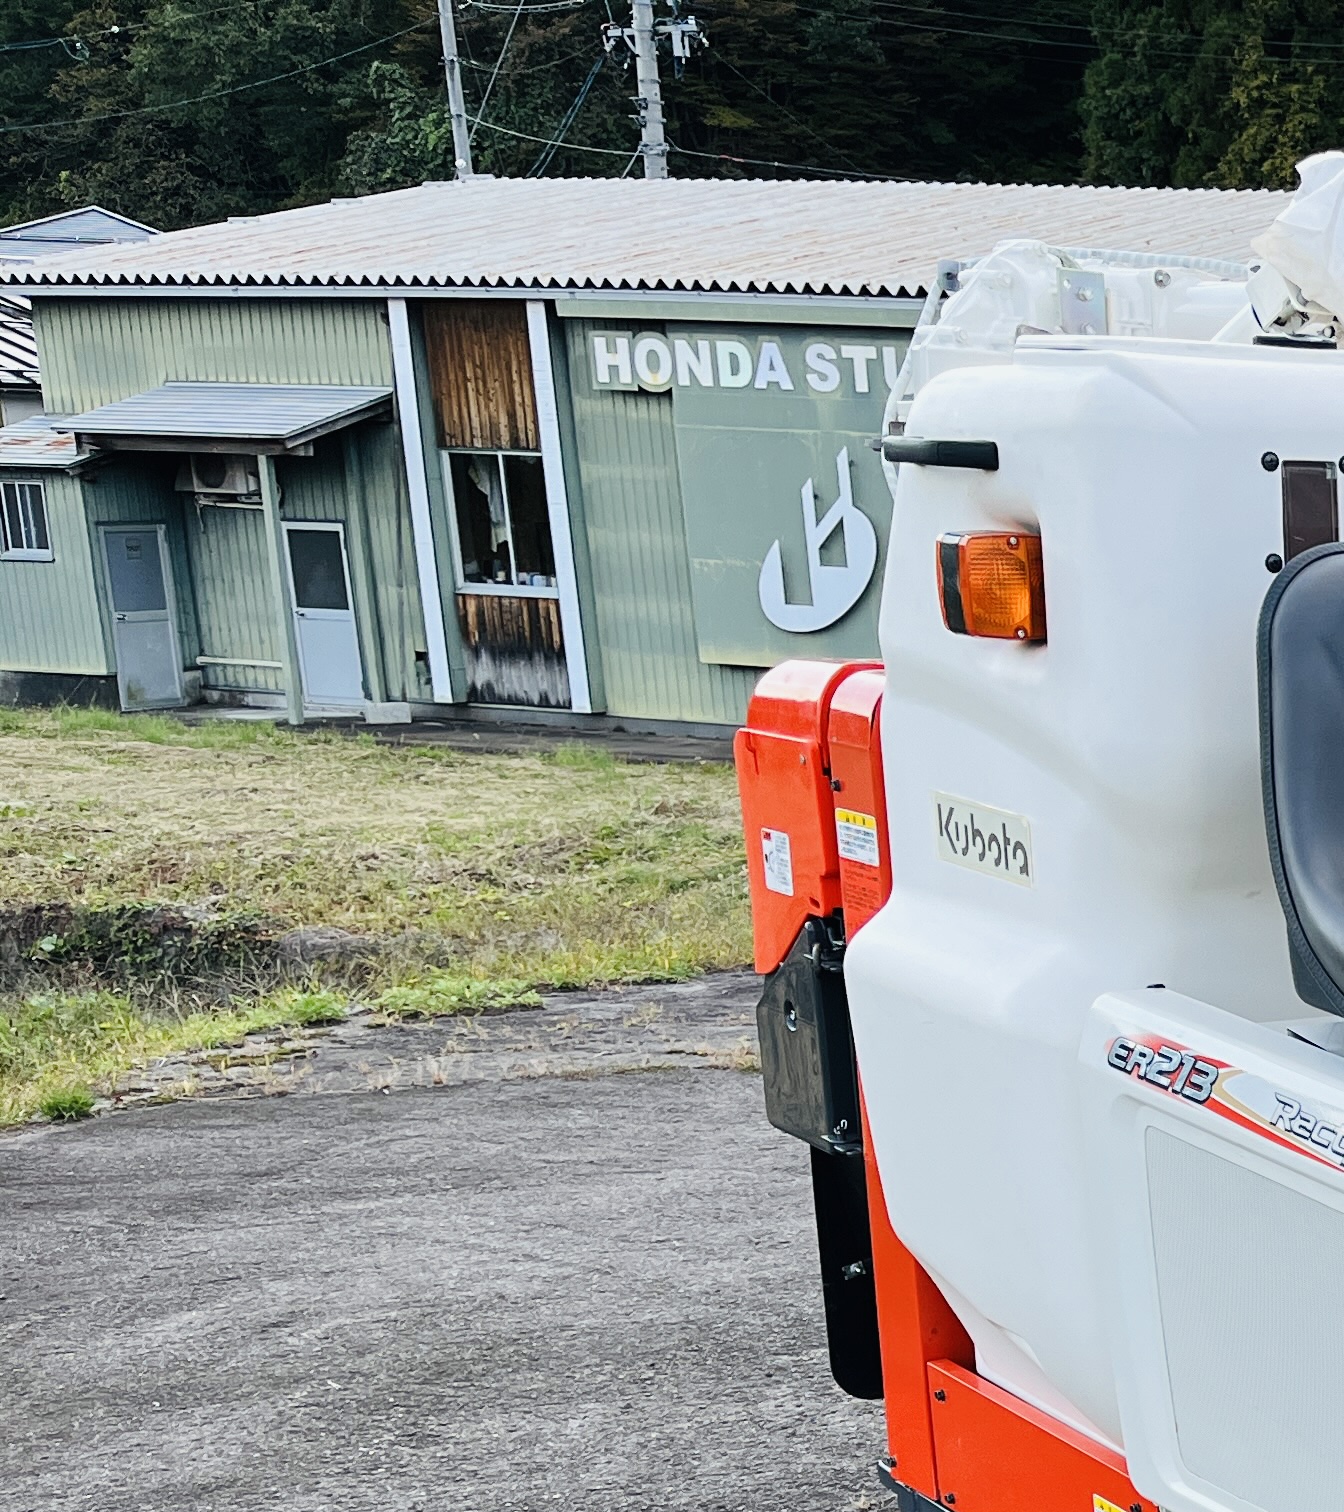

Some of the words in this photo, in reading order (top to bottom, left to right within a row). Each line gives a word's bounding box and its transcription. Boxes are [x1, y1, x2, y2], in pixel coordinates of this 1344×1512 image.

[593, 336, 794, 393] HONDA
[937, 803, 1030, 877] Kubota
[1107, 1036, 1219, 1105] ER213
